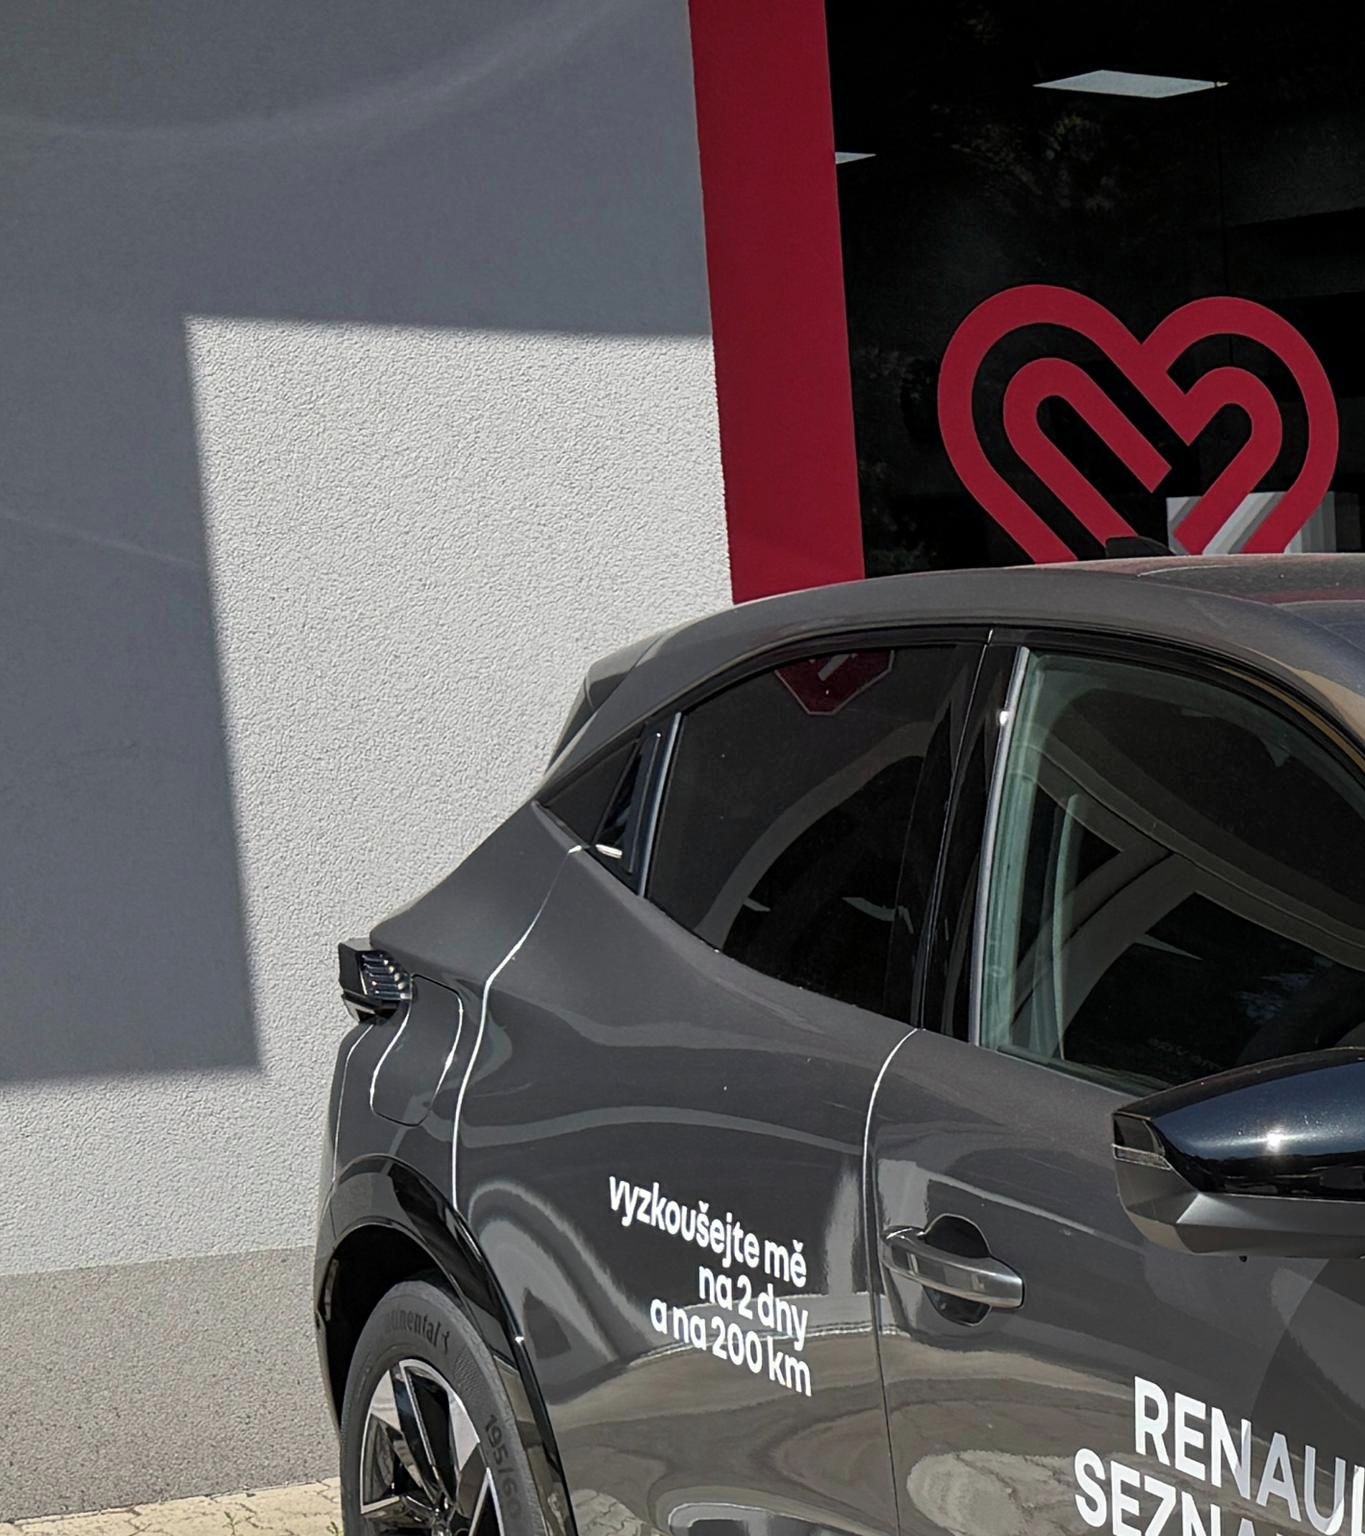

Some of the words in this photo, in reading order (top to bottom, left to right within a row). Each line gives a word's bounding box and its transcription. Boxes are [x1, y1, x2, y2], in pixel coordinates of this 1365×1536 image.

[609, 1176, 760, 1268] vyzkoušejte
[764, 1239, 807, 1287] mě
[650, 1299, 667, 1335] a
[673, 1307, 706, 1351] na
[711, 1316, 763, 1373] 200
[768, 1336, 812, 1397] km
[698, 1266, 733, 1311] na
[735, 1275, 753, 1320] 2
[757, 1283, 808, 1351] dny
